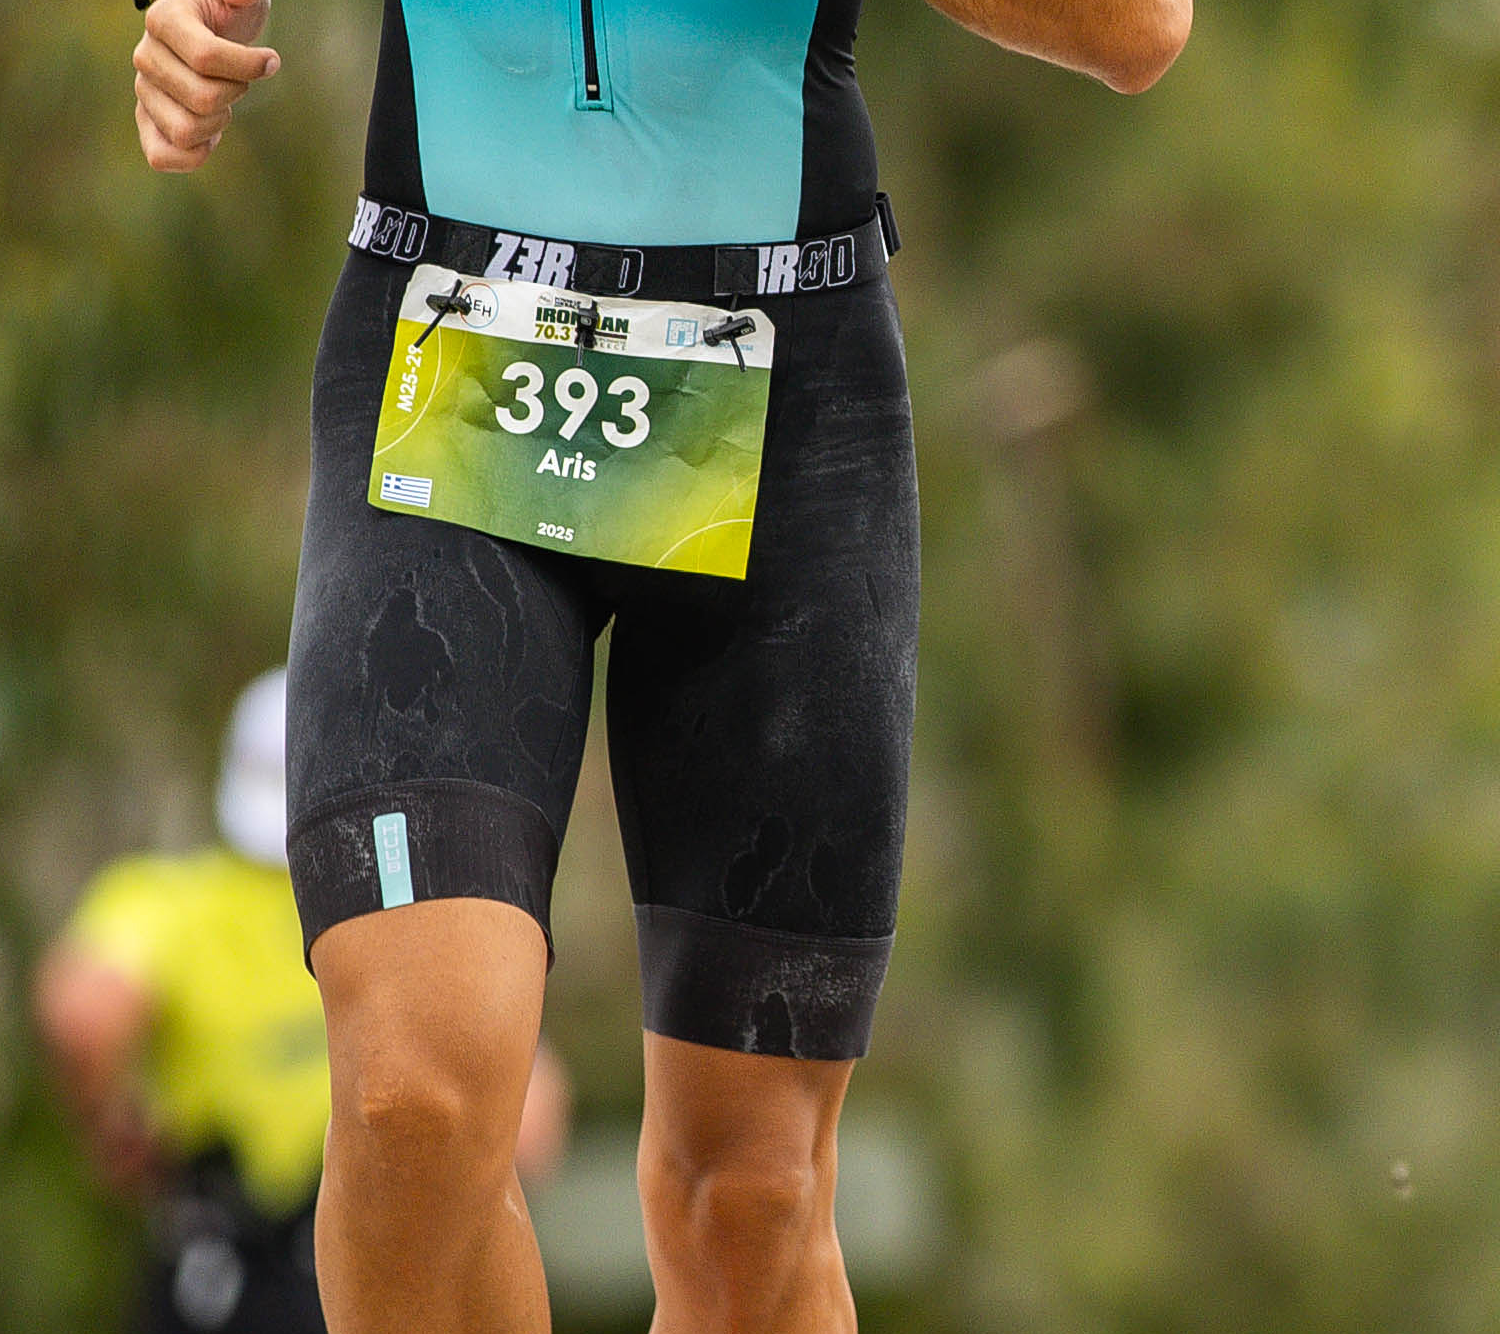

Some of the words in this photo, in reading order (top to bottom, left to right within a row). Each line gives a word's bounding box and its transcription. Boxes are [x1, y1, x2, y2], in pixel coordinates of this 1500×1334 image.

[534, 323, 571, 341] 70.3
[396, 344, 423, 413] M25-29
[495, 361, 650, 449] 393
[535, 448, 597, 481] Aris
[536, 522, 575, 542] 2025
